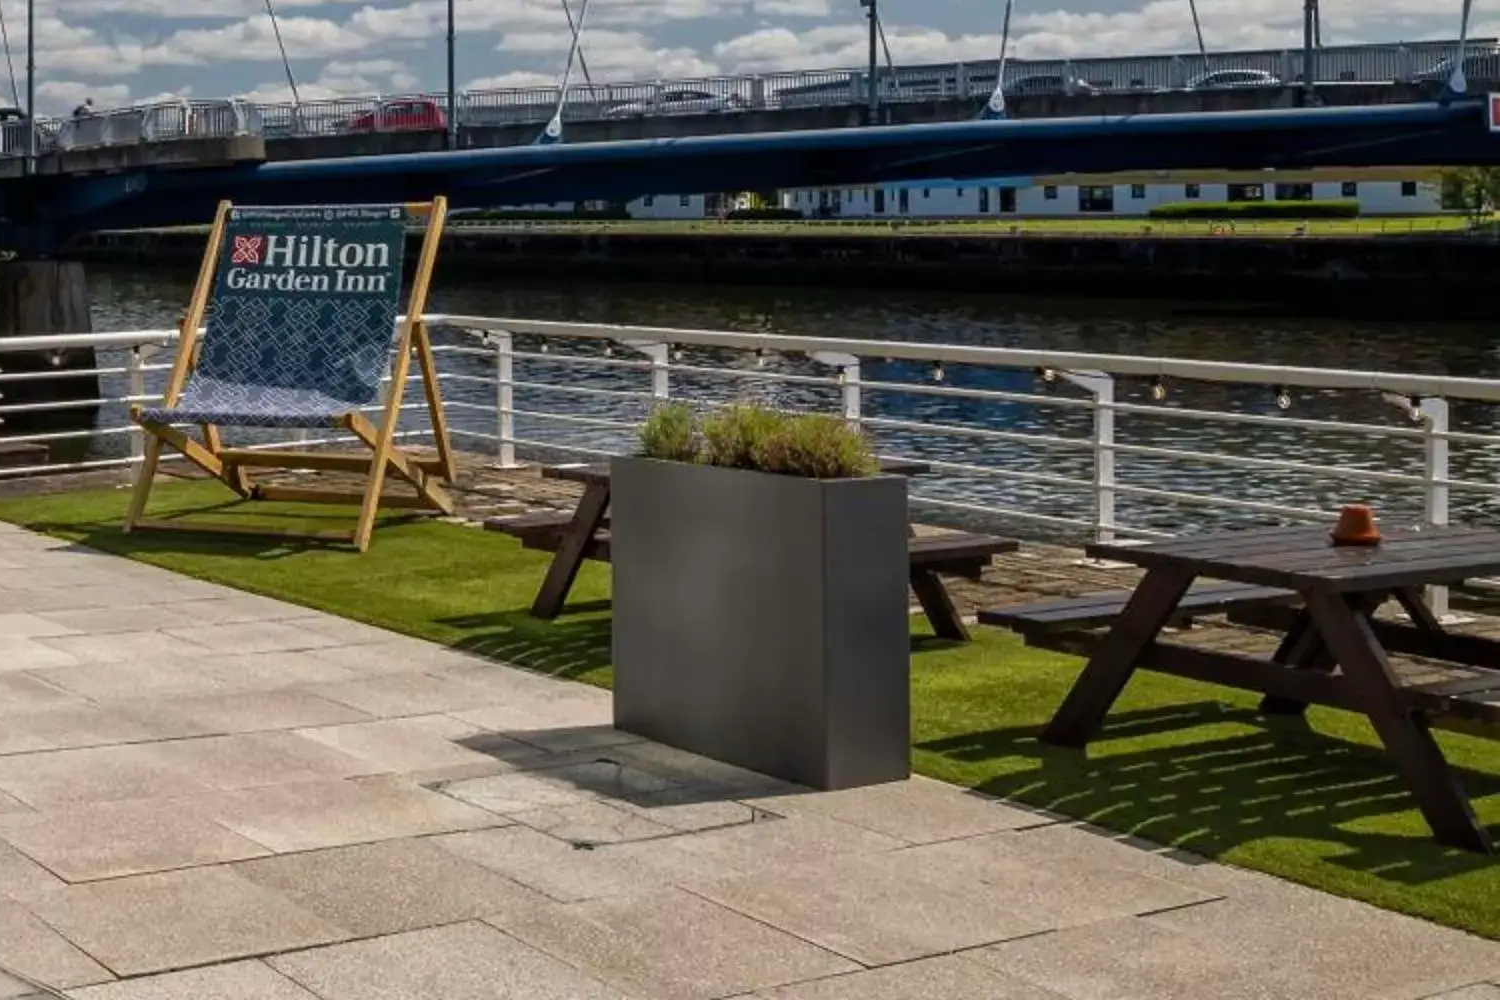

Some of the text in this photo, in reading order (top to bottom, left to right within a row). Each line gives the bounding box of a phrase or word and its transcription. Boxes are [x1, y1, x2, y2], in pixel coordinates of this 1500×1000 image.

[264, 234, 389, 267] Hilton
[227, 267, 386, 293] Garden Inn
